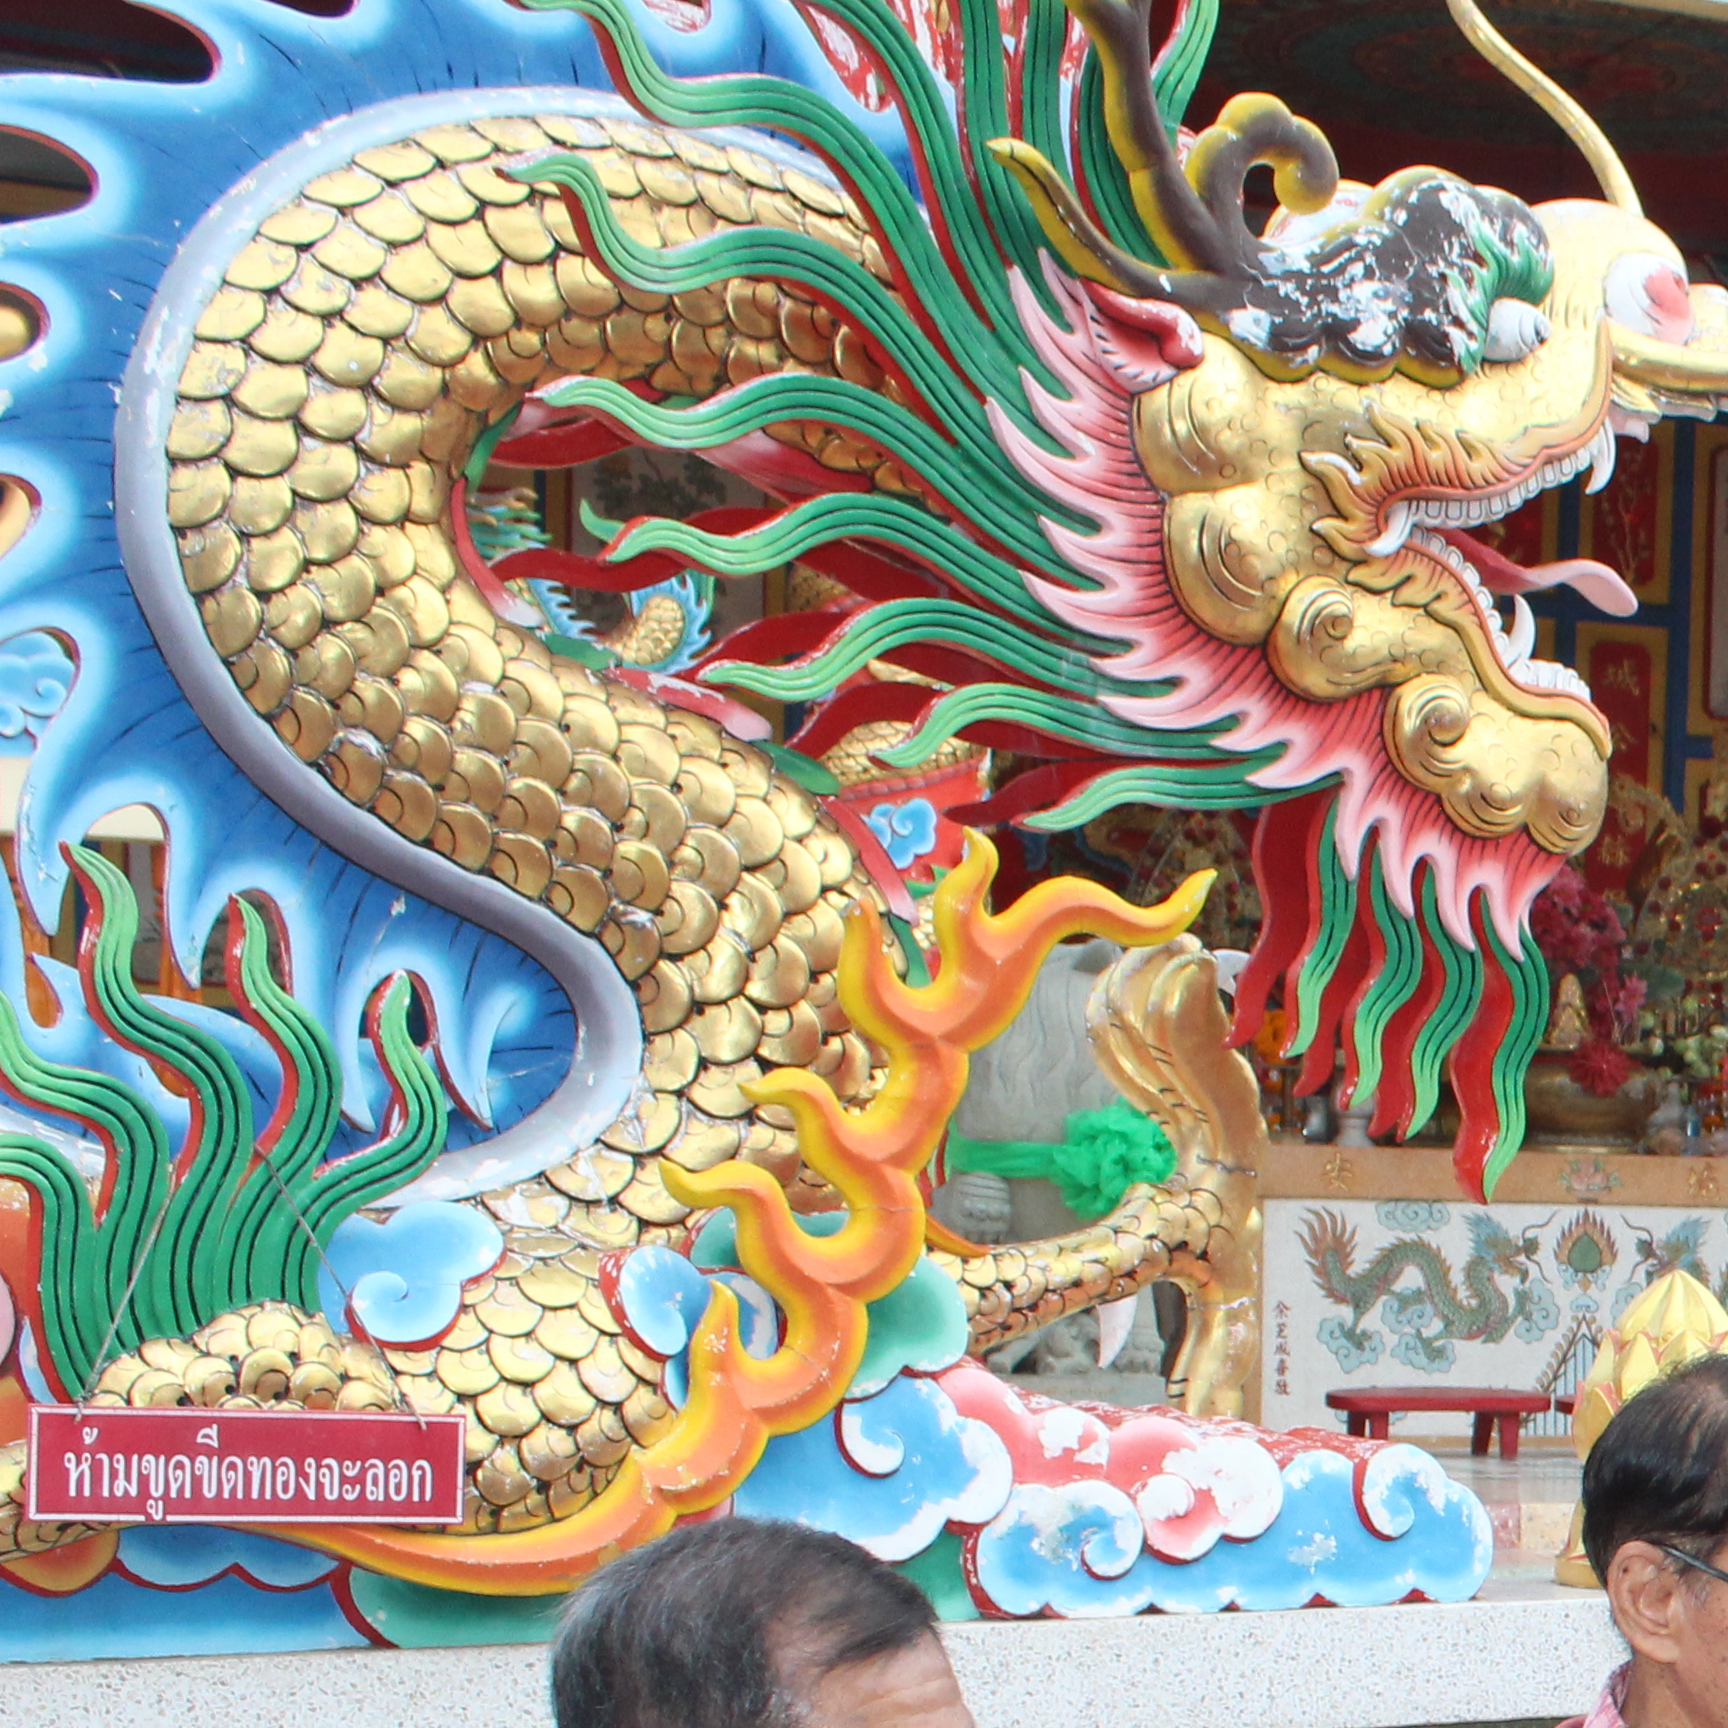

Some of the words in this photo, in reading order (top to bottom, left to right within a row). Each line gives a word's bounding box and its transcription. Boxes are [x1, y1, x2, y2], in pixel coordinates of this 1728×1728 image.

[62, 1424, 434, 1521] ห้ามขูดขีดทองจะลอก
